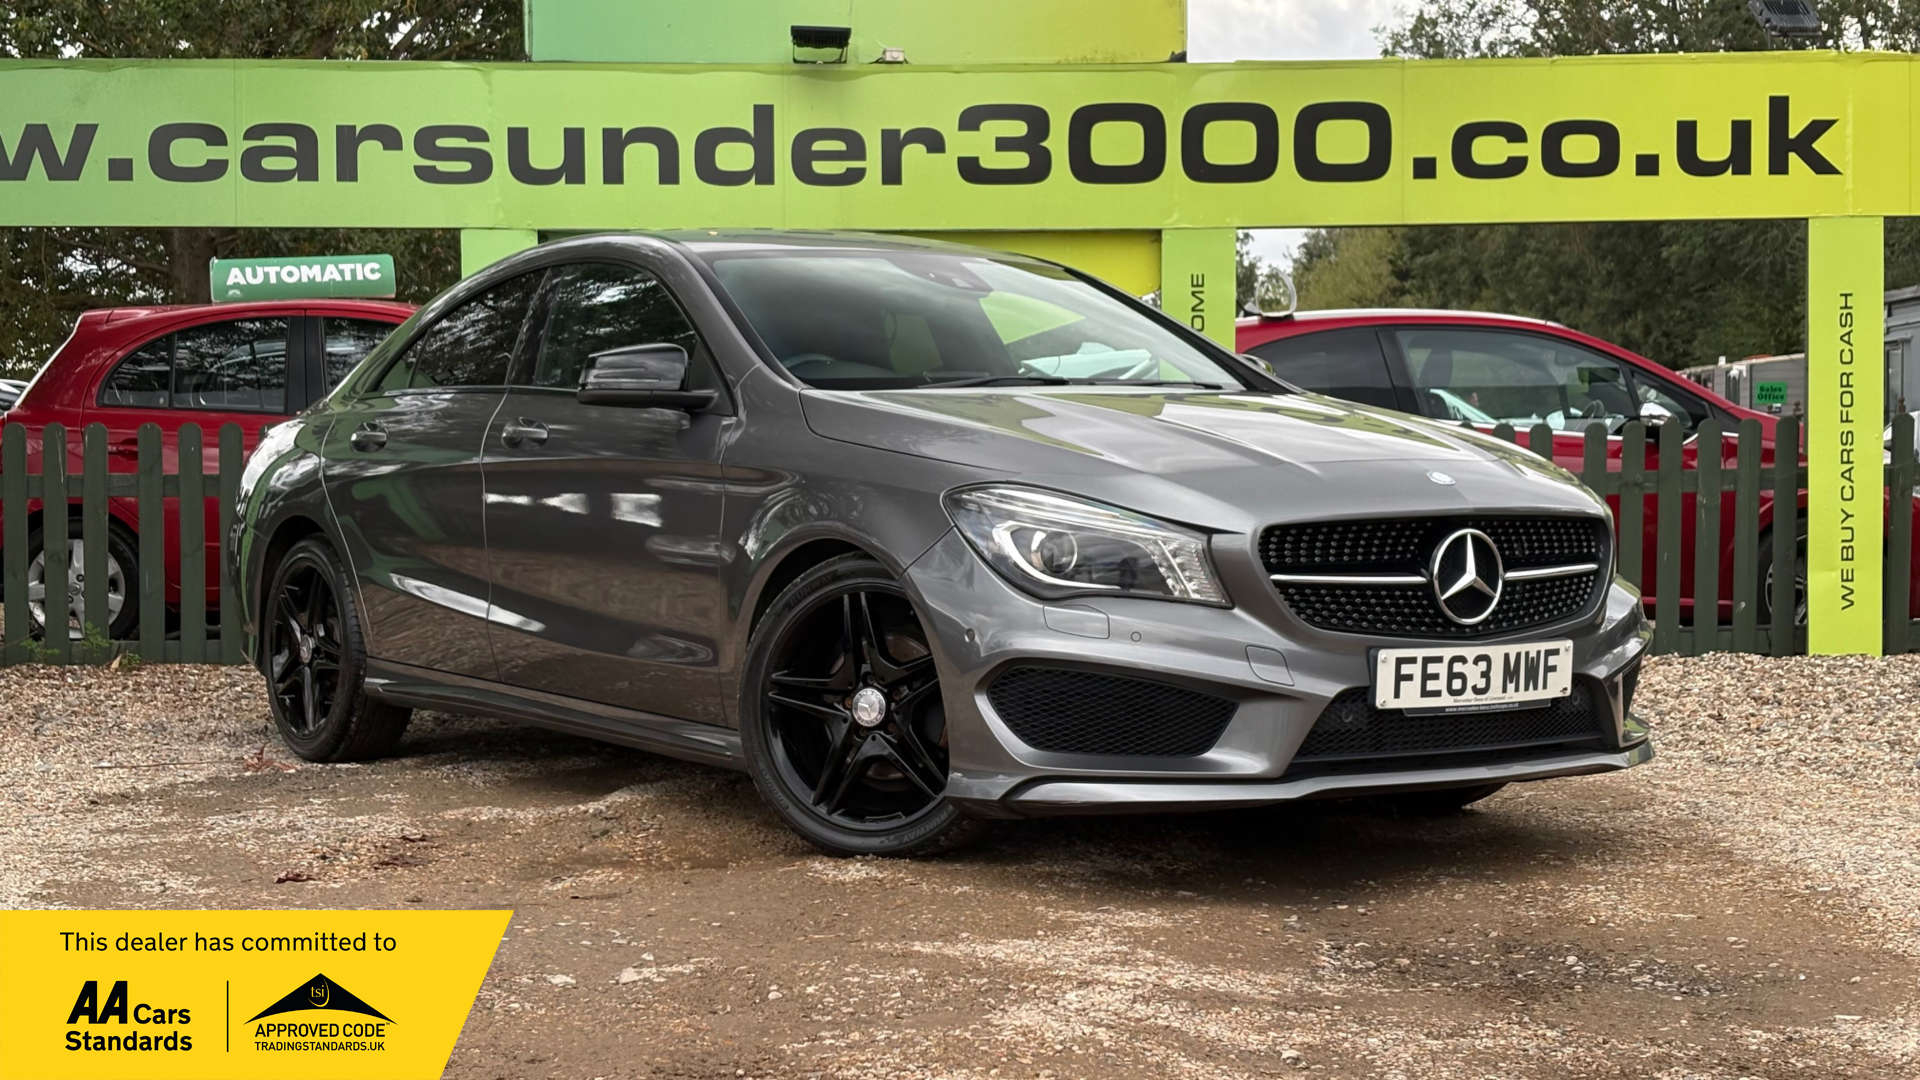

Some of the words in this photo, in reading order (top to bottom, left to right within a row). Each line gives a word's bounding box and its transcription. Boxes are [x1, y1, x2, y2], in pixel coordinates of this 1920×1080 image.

[226, 262, 381, 286] AUTOMATIC
[1839, 292, 1855, 365] CASH
[1757, 393, 1785, 401] Office
[1839, 371, 1855, 424] FOR
[1839, 430, 1855, 502] CARS
[1839, 508, 1855, 562] BUY
[1839, 567, 1855, 611] WE
[1393, 653, 1492, 699] FE63
[1501, 648, 1560, 694] MWF
